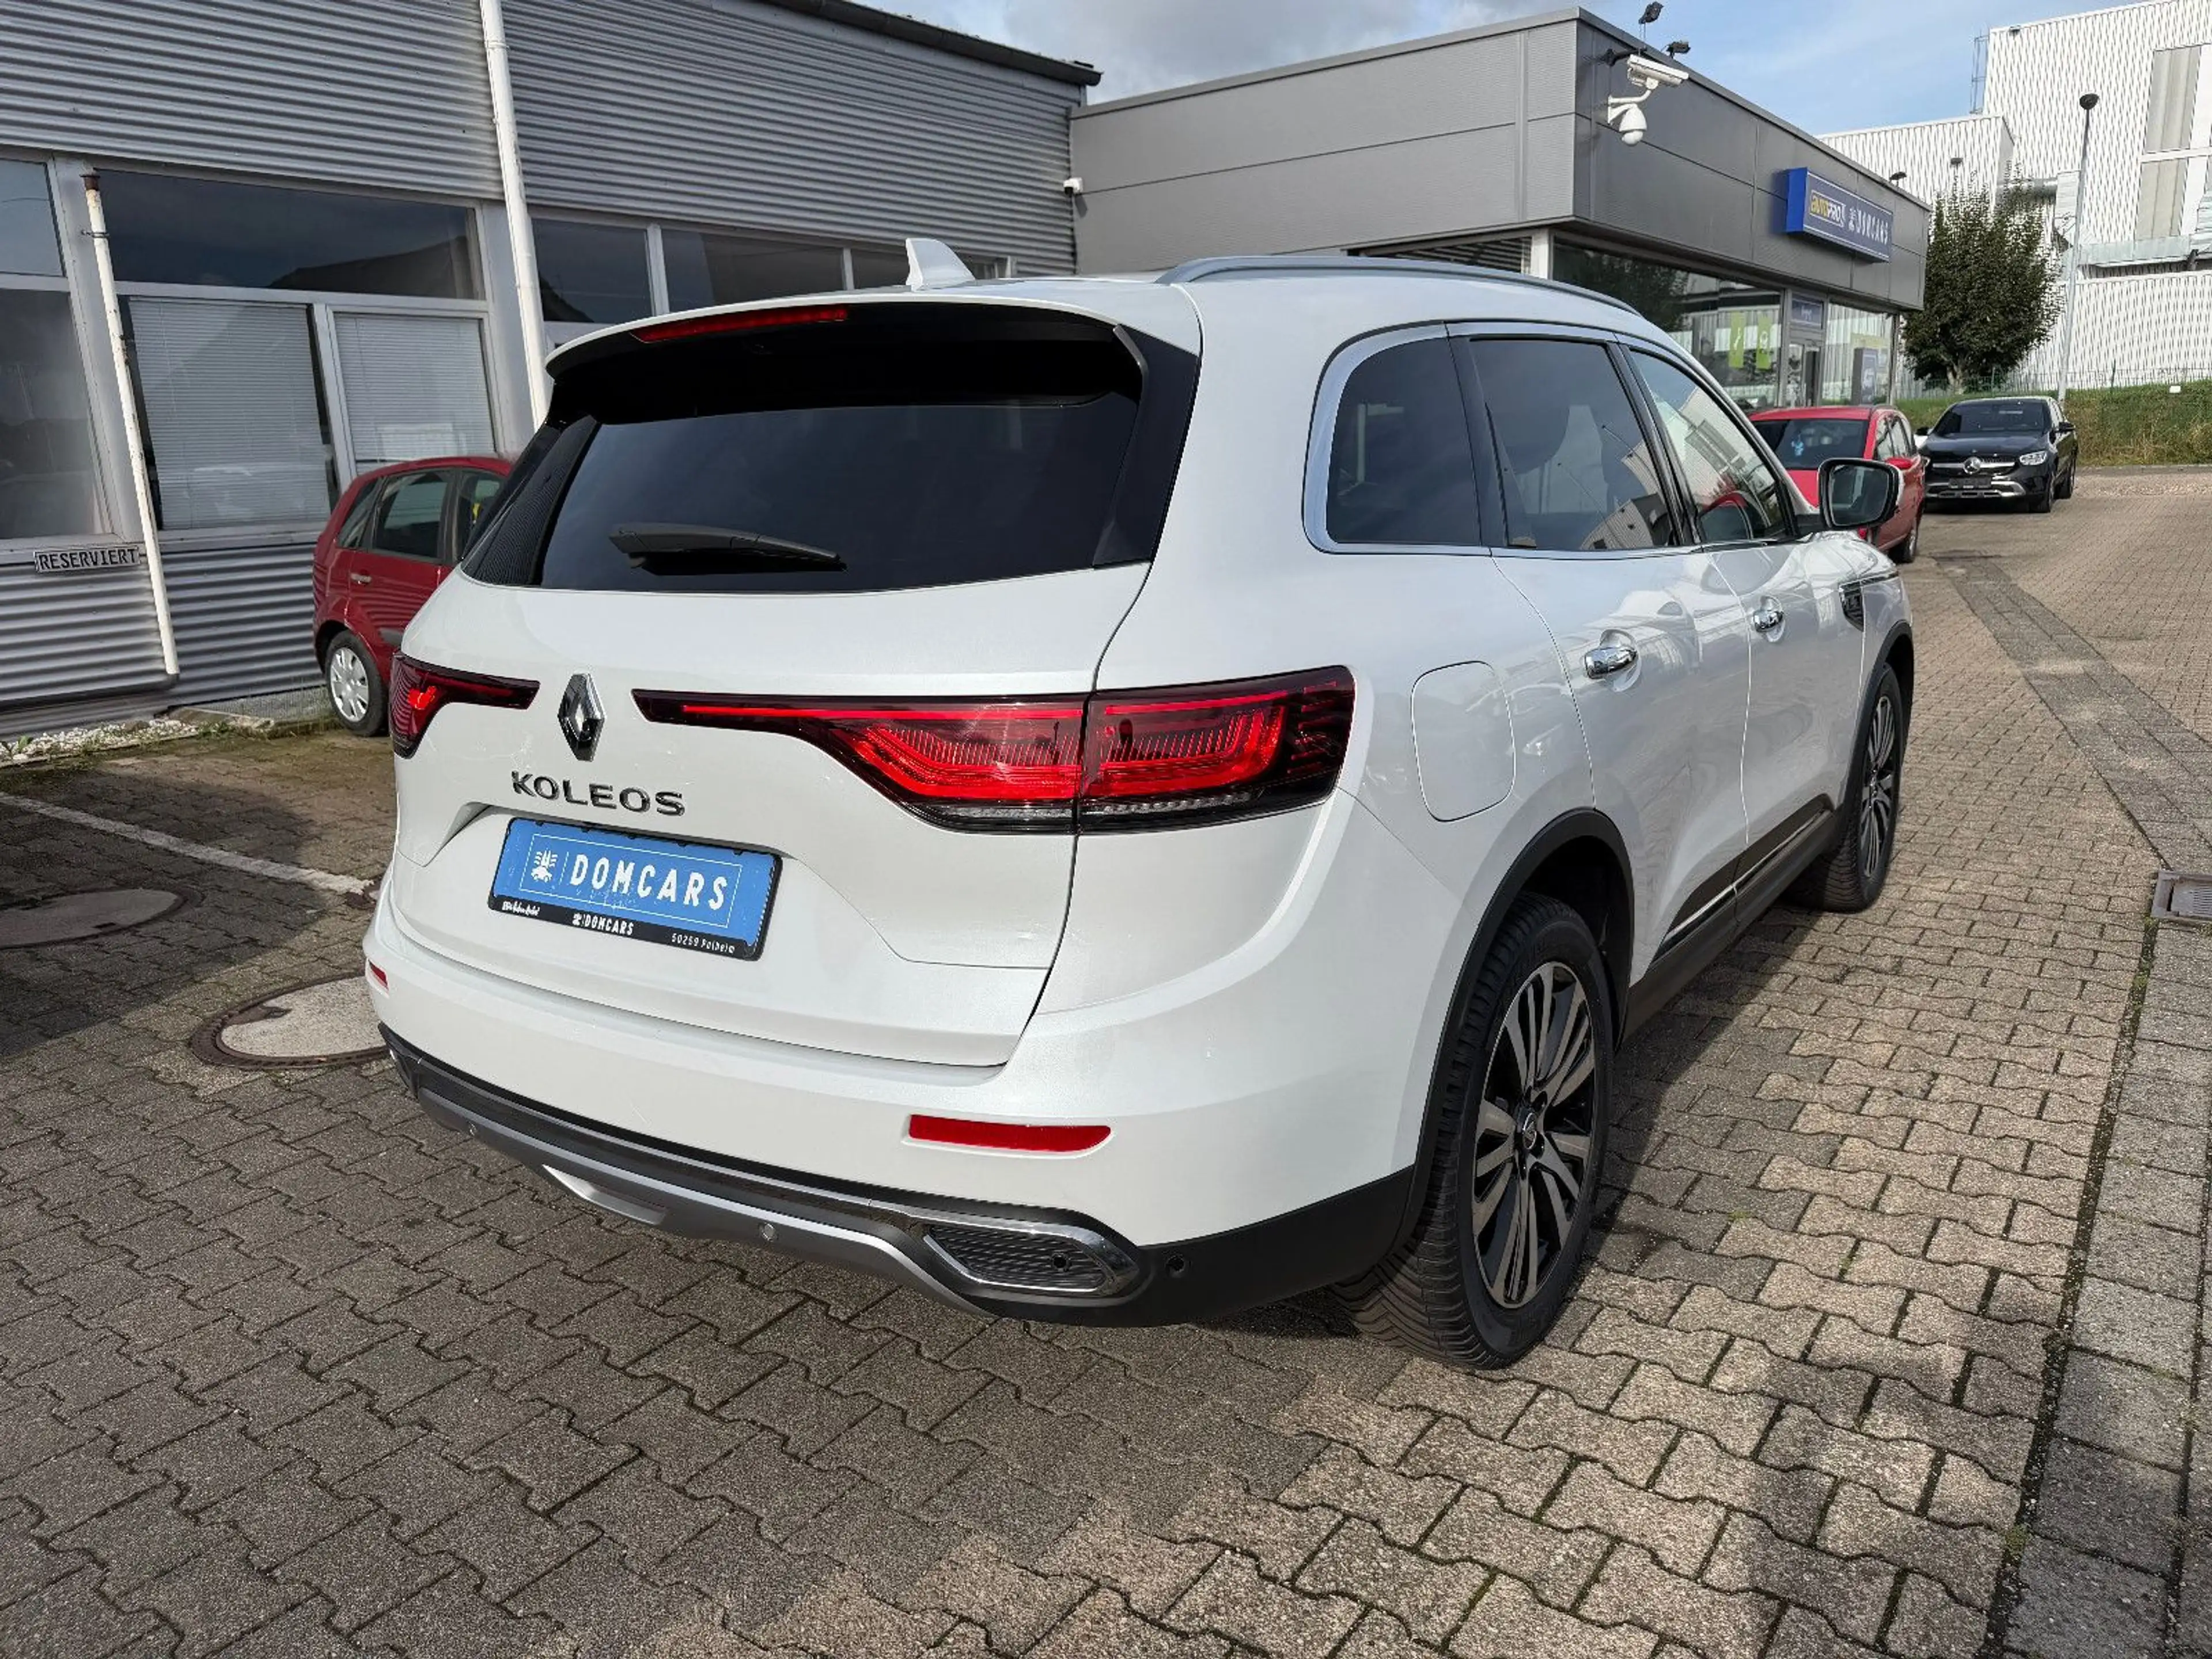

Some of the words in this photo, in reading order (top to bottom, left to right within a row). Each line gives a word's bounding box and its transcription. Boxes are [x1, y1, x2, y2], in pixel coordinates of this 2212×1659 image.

[38, 548, 136, 570] RESERVIERT
[511, 770, 686, 816] KOLEOS
[570, 853, 728, 911] DOMCARS
[585, 914, 634, 935] DOMCARS
